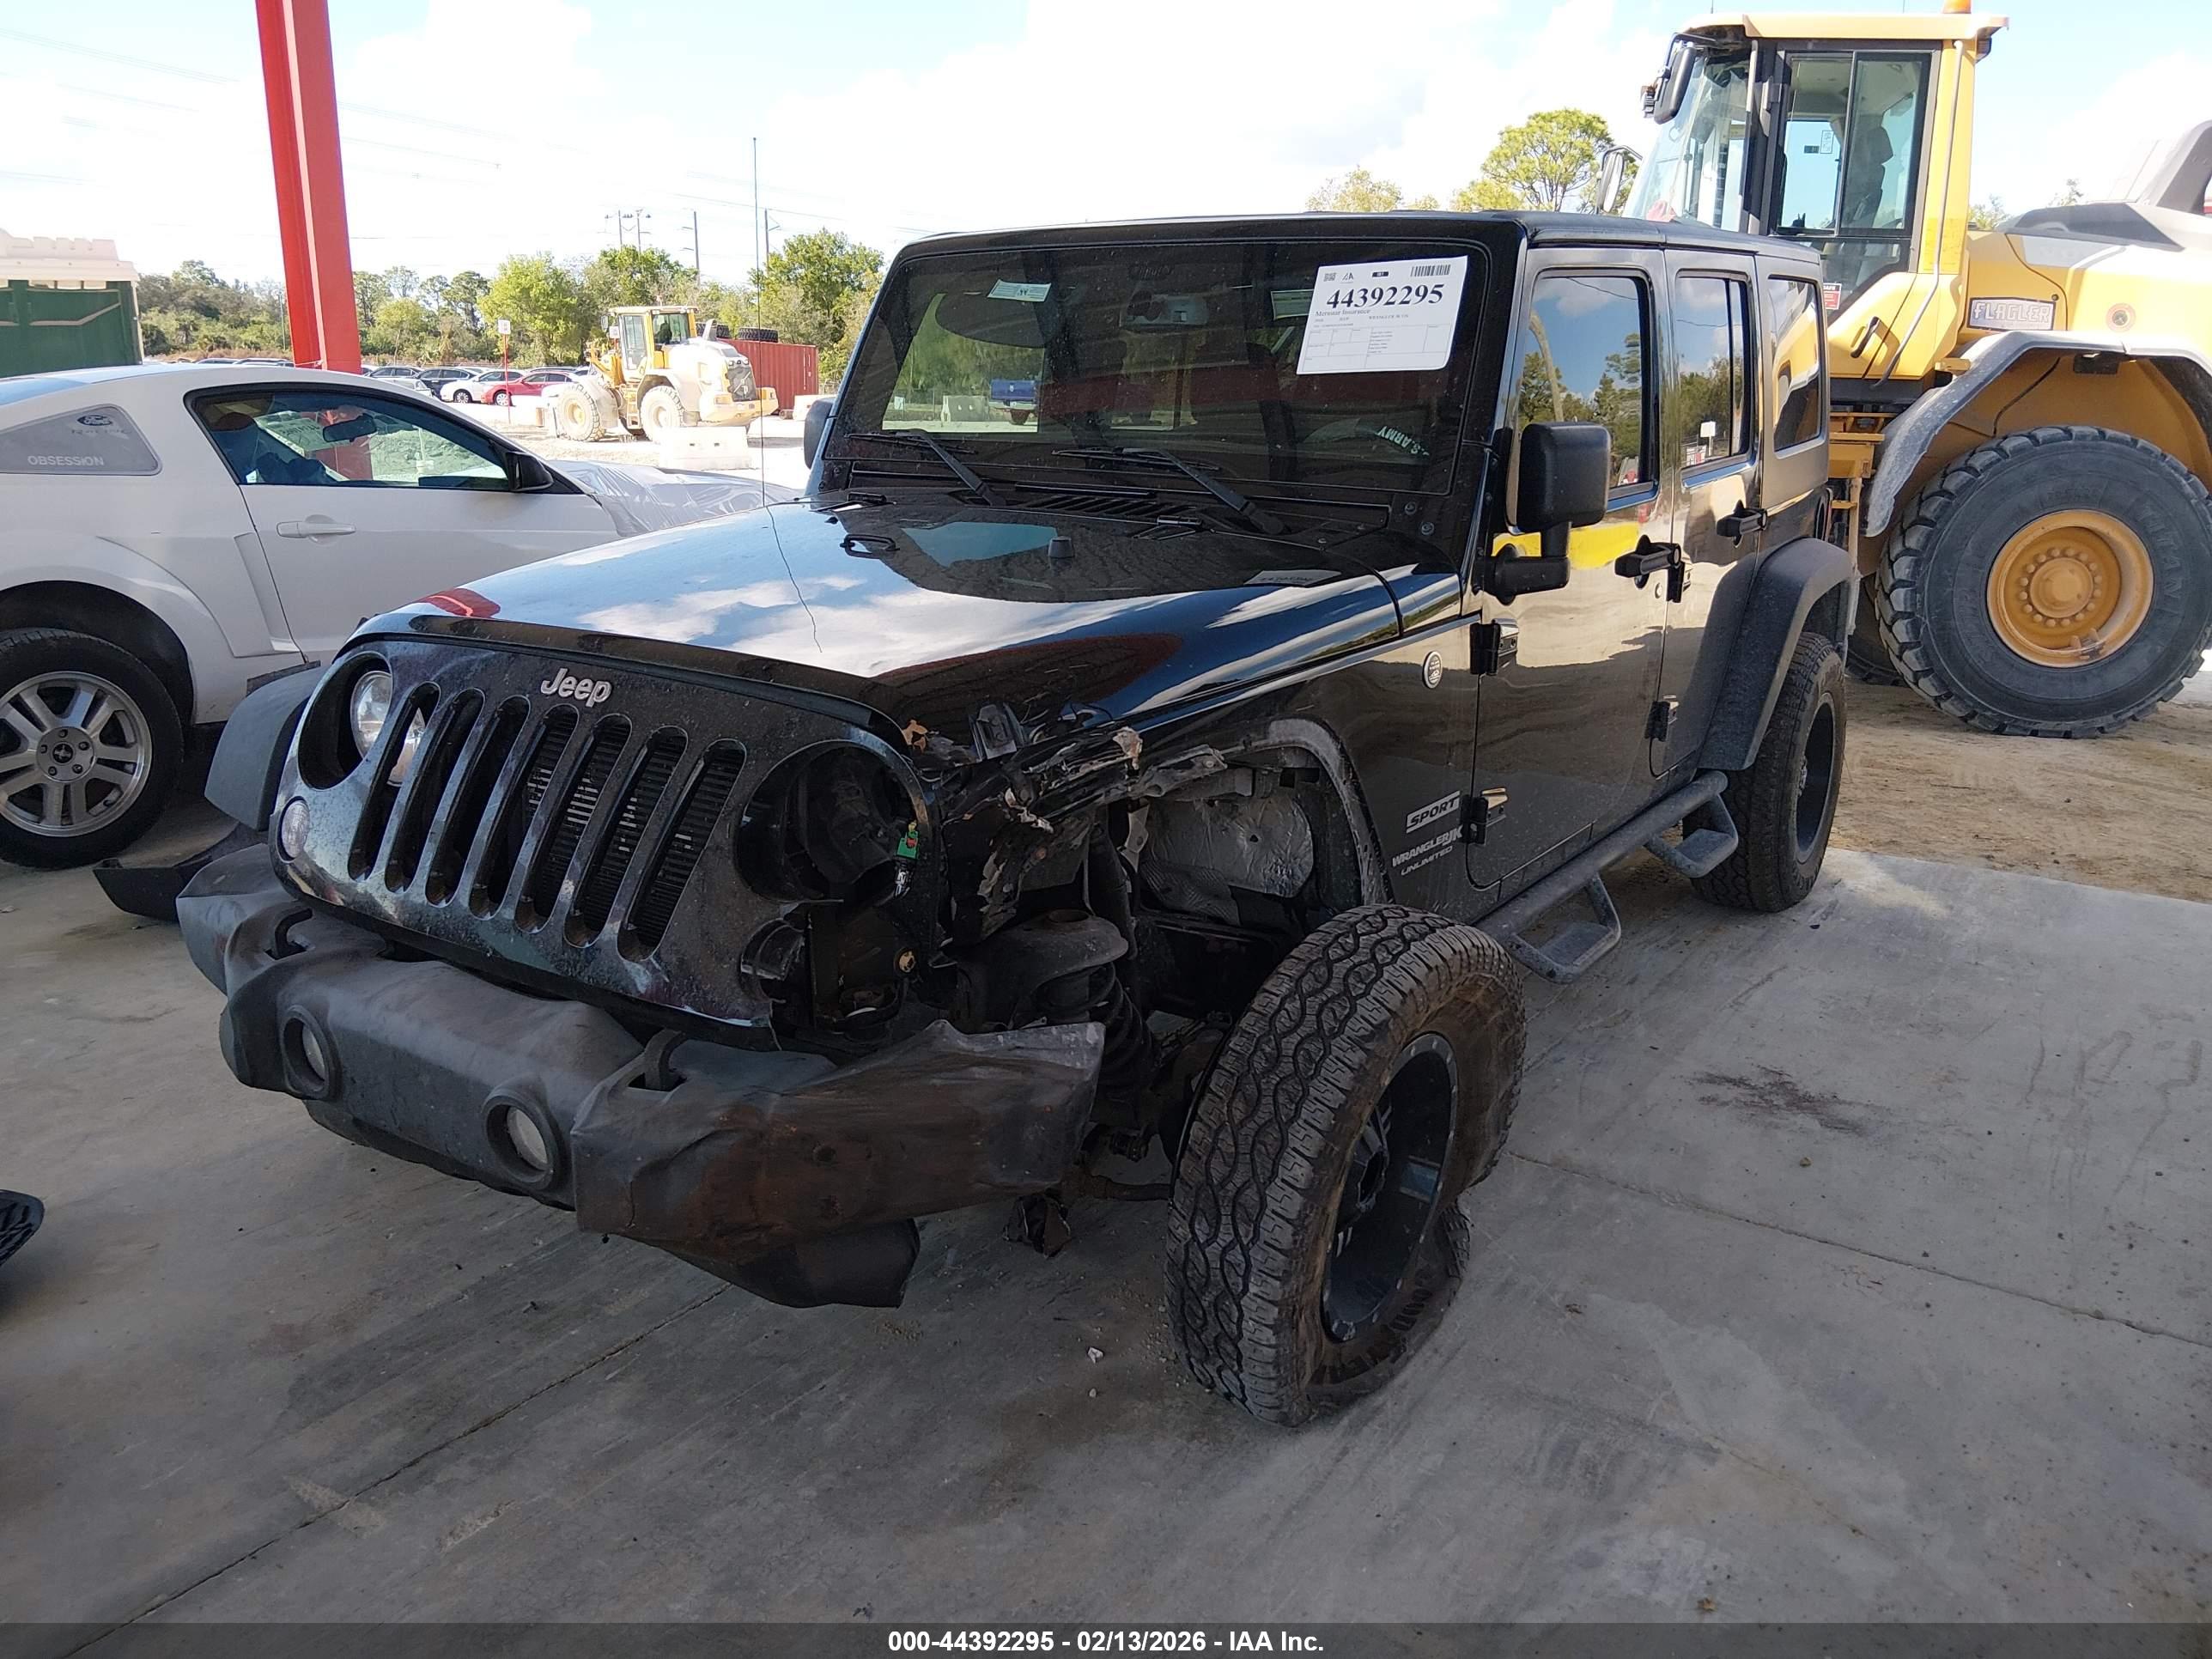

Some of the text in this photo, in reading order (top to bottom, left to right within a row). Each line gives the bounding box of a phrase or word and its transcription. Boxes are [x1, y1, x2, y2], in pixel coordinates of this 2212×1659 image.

[1327, 283, 1445, 309] 44392295
[1973, 301, 2051, 323] FLAGLER
[27, 455, 105, 466] OBSESSION
[540, 667, 612, 708] Jeep
[1410, 797, 1459, 825] SPORT
[1401, 845, 1454, 876] UNLIMITED
